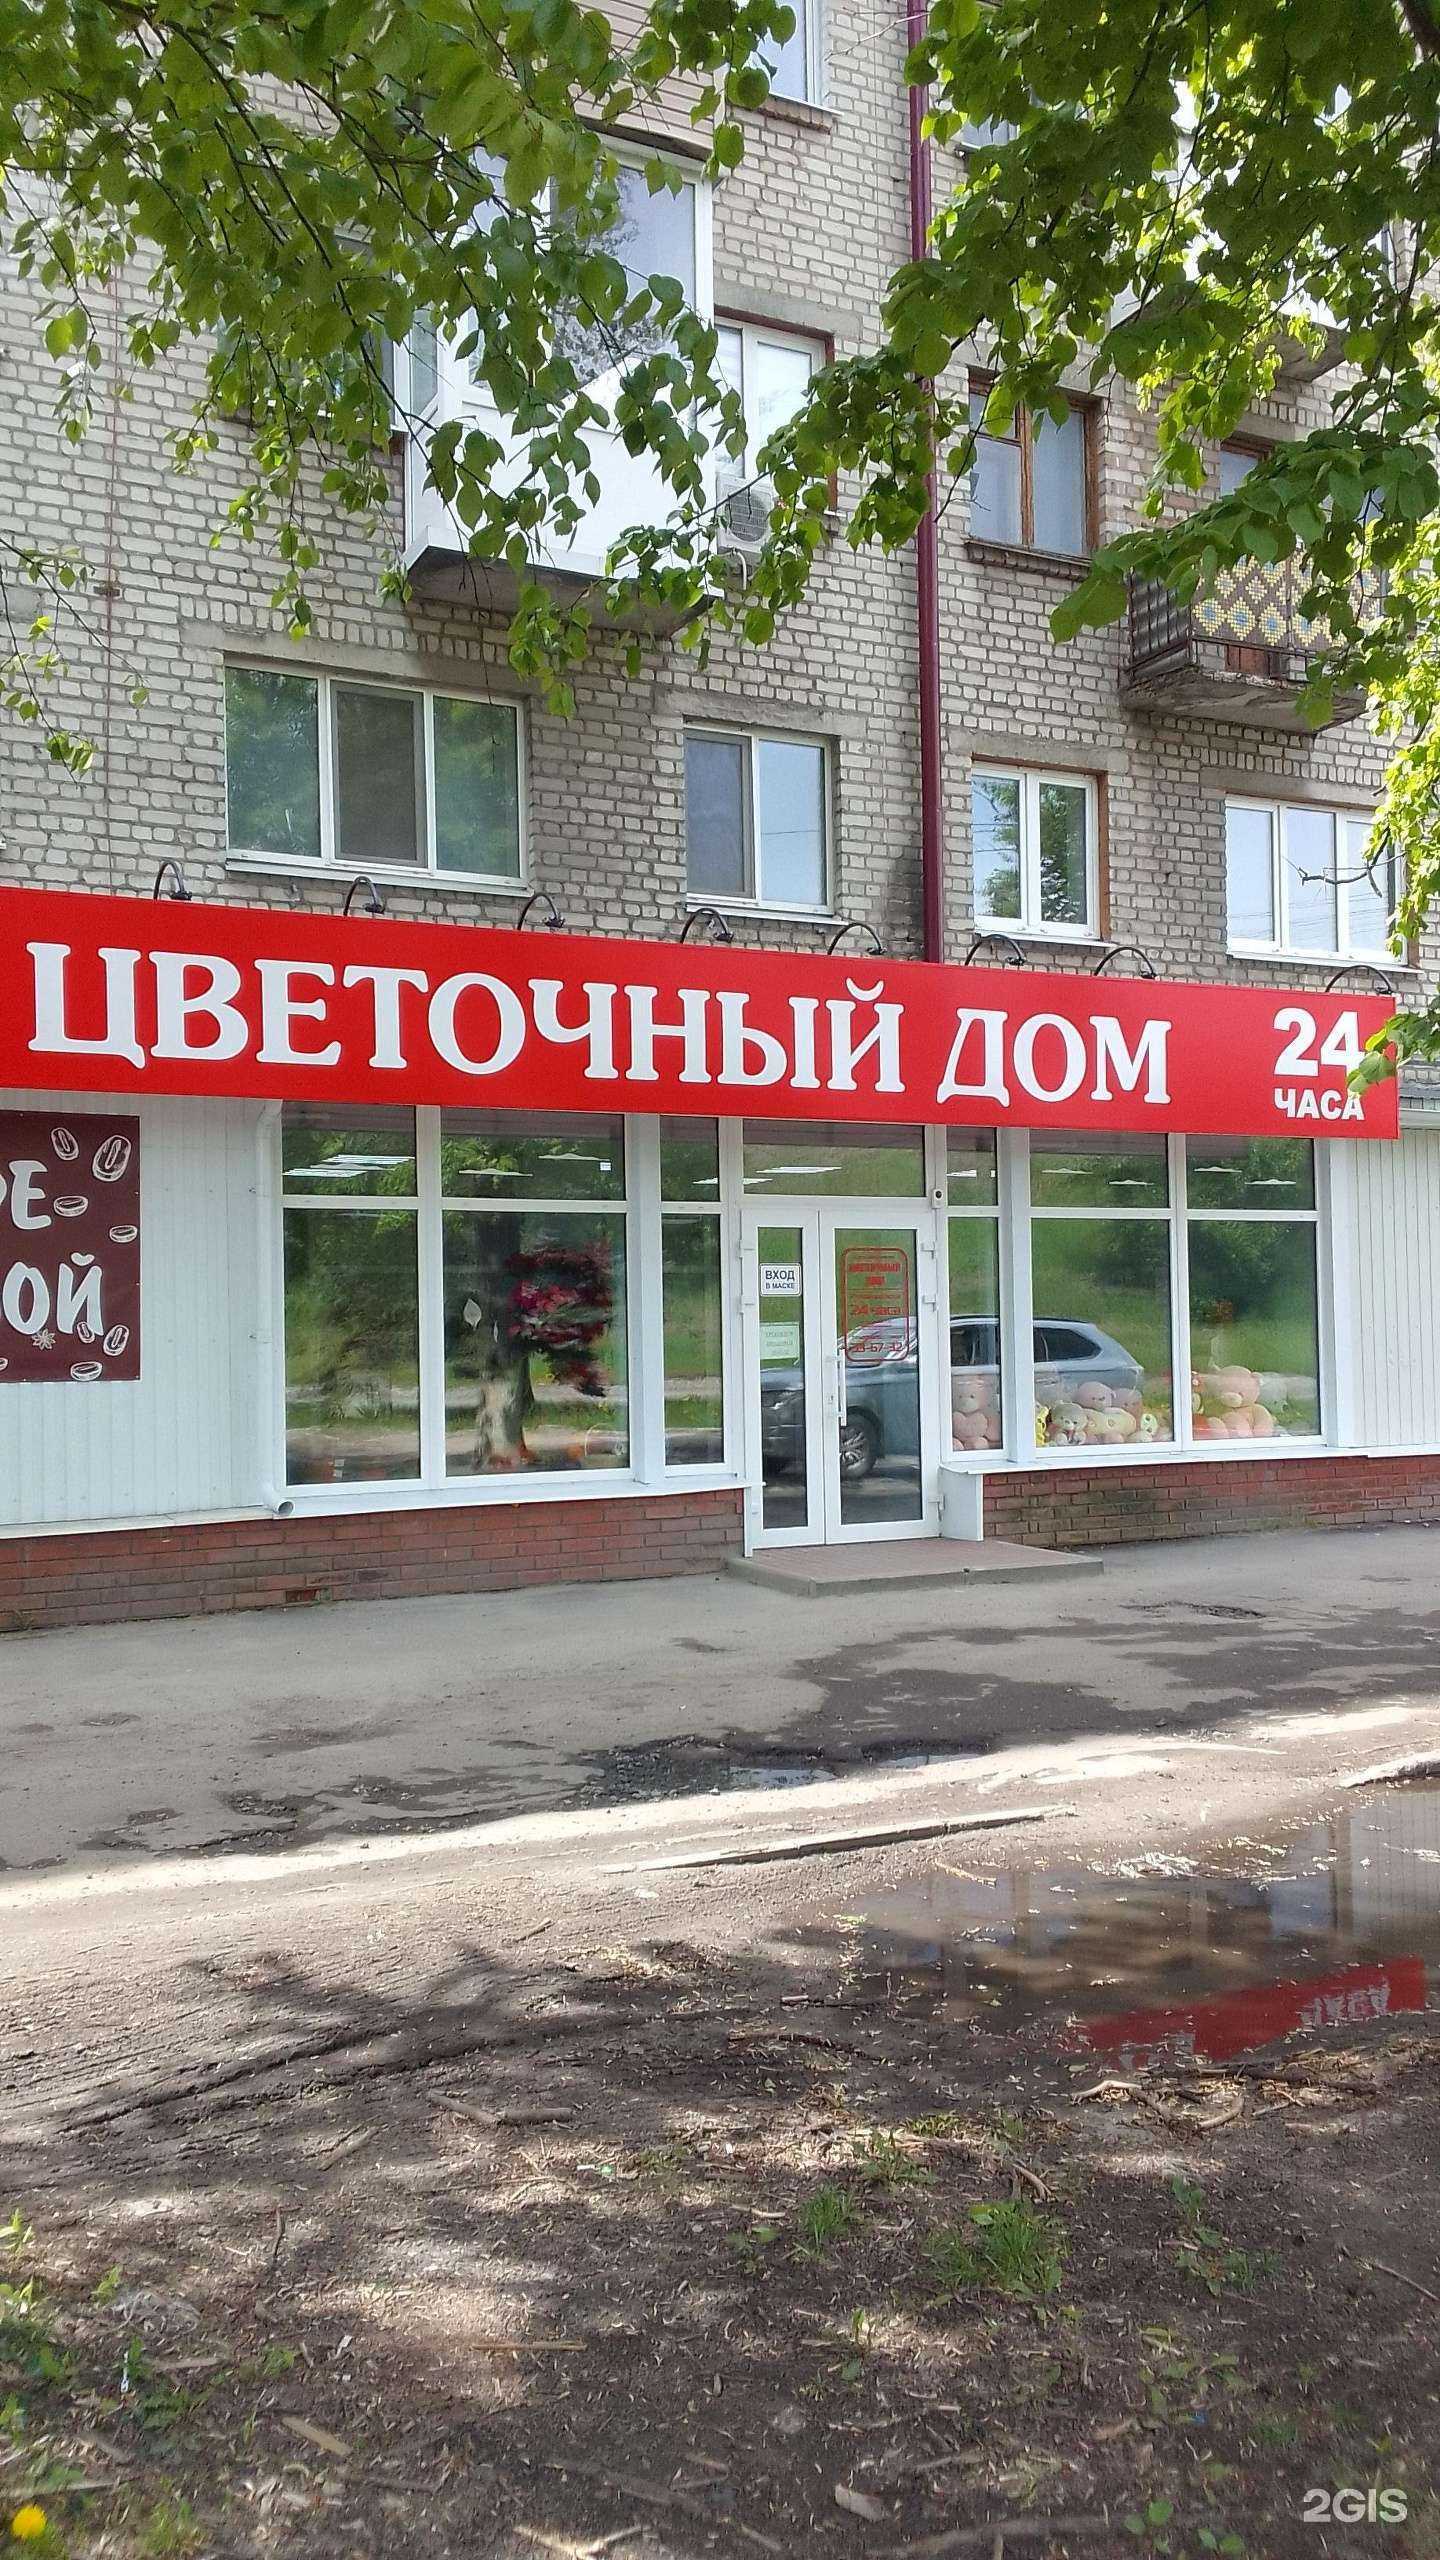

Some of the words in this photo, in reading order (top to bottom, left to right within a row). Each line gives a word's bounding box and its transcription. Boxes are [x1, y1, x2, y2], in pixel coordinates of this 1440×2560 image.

[27, 942, 905, 1092] ЦВЕТОЧНЫЙ
[937, 1007, 1172, 1108] ДОМ
[1273, 1007, 1366, 1081] 24
[1274, 1088, 1365, 1121] ЧАСА
[0, 1160, 52, 1230] Е
[0, 1252, 104, 1337] ОЙ
[765, 1270, 795, 1281] ВХОД
